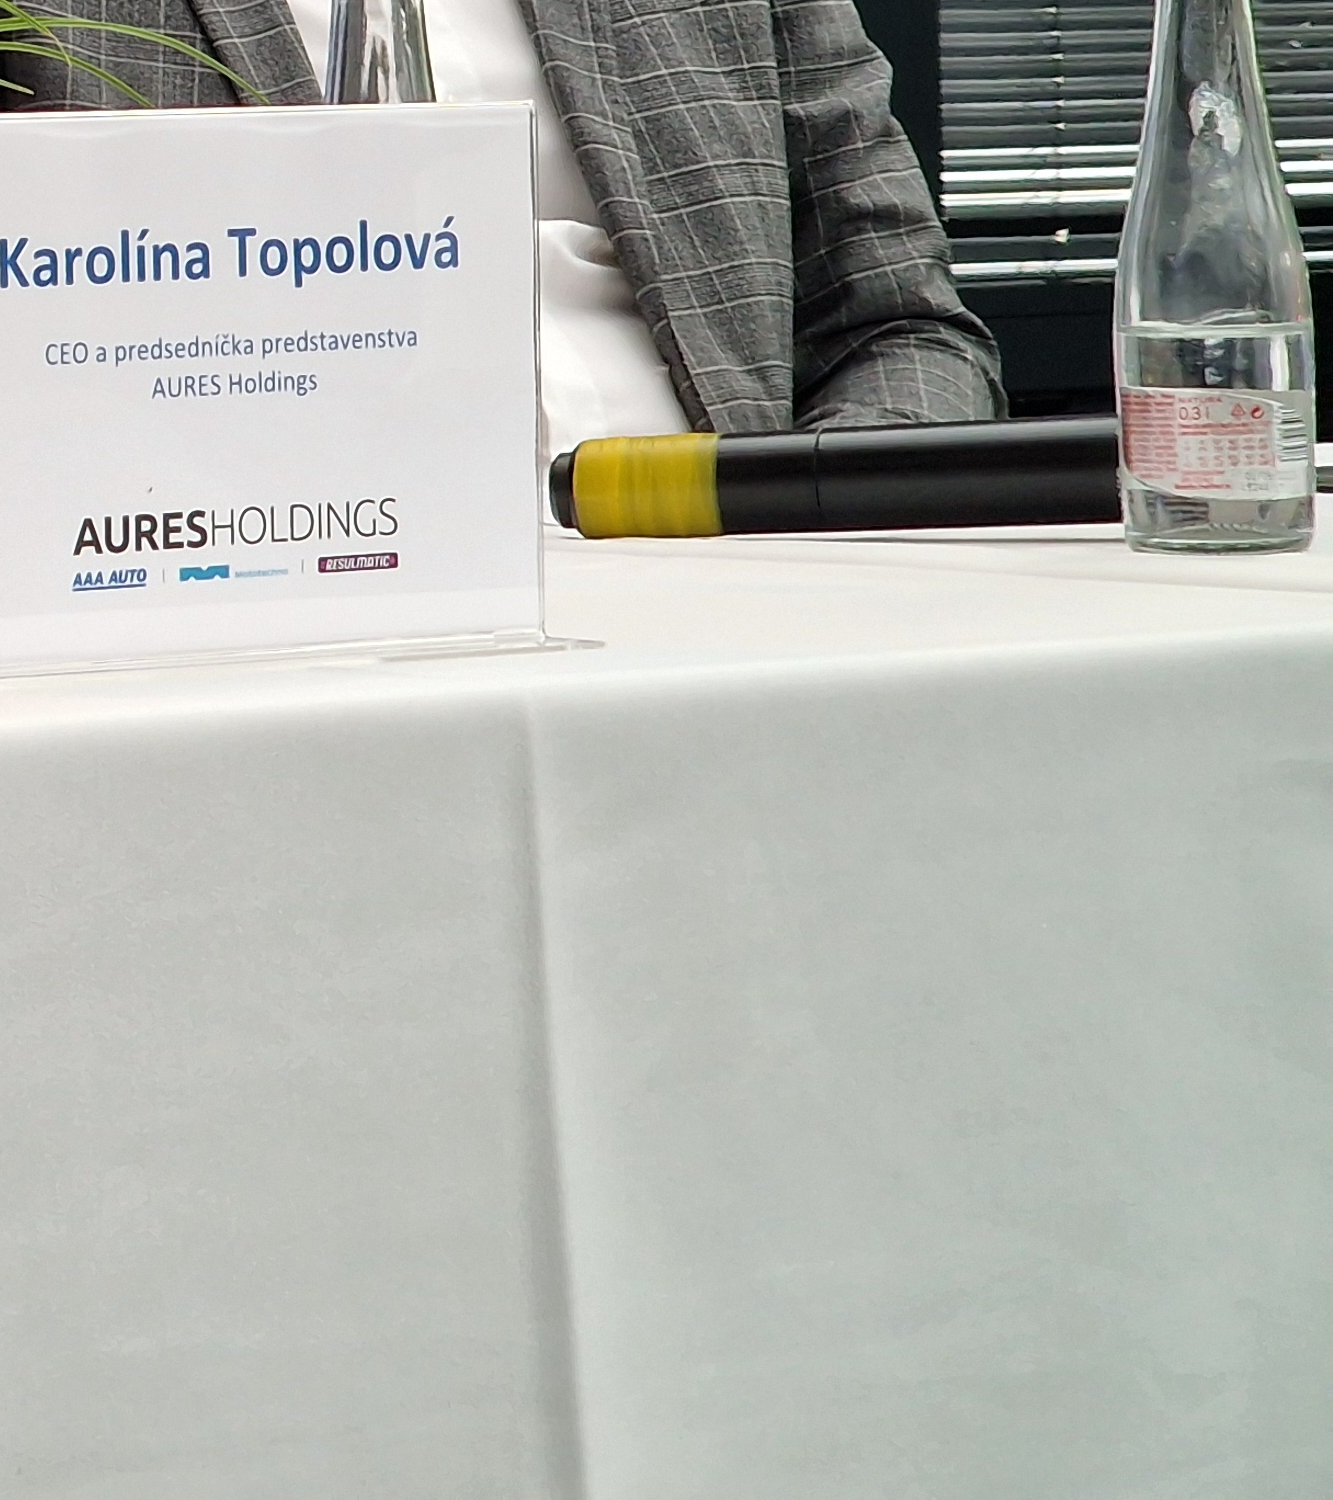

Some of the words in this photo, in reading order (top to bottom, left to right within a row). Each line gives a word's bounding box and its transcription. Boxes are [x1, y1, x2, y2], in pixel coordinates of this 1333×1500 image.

[226, 215, 459, 289] Topolová
[45, 341, 89, 366] CEO
[95, 346, 107, 363] a
[114, 333, 254, 368] predsedníčka
[261, 328, 418, 360] predstavenstva
[151, 374, 222, 400] AURES
[228, 370, 318, 397] Holdings
[72, 571, 105, 587] AAA
[108, 568, 147, 584] AUTO
[325, 555, 391, 570] RESULMATIC
